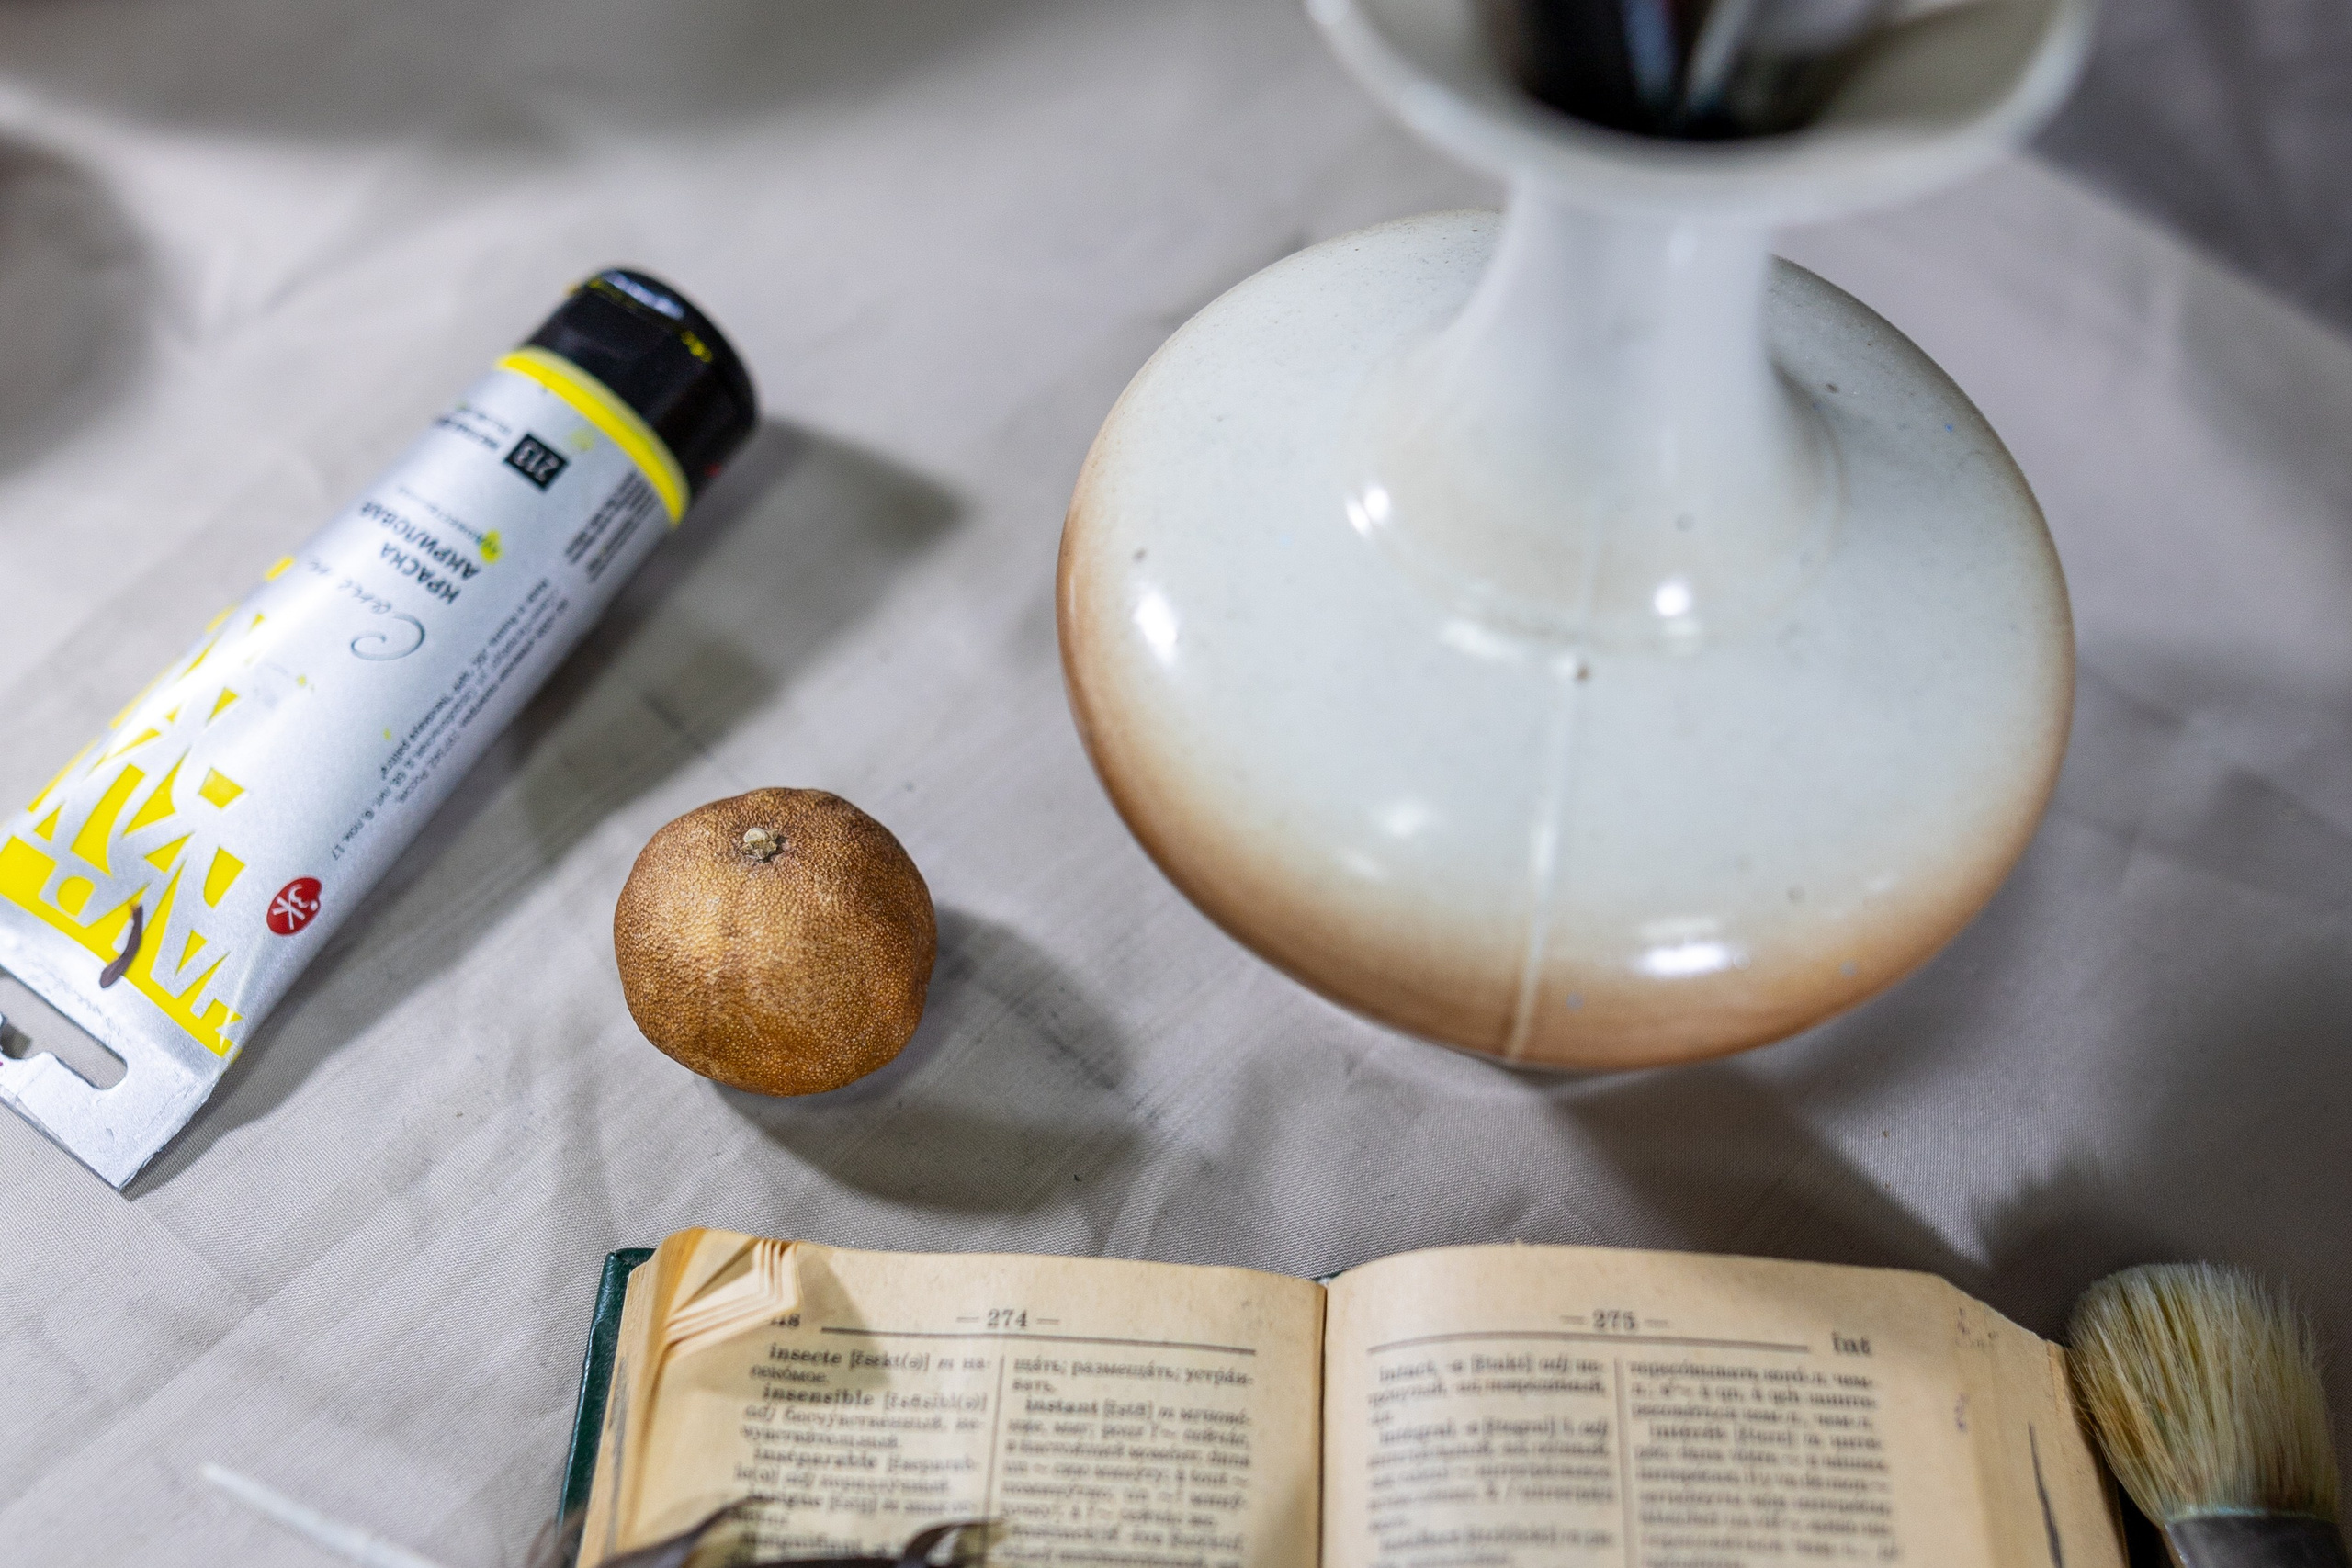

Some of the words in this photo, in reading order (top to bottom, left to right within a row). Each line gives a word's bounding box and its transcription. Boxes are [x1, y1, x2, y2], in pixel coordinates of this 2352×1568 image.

[512, 437, 561, 483] 213
[380, 543, 460, 605] КРАСКА
[328, 843, 345, 861] 17
[986, 1308, 1029, 1330] 274
[1592, 1310, 1636, 1331] 275
[770, 1343, 842, 1363] insecte
[1831, 1332, 1872, 1356] int
[763, 1382, 875, 1406] insensible
[1025, 1397, 1098, 1415] instant
